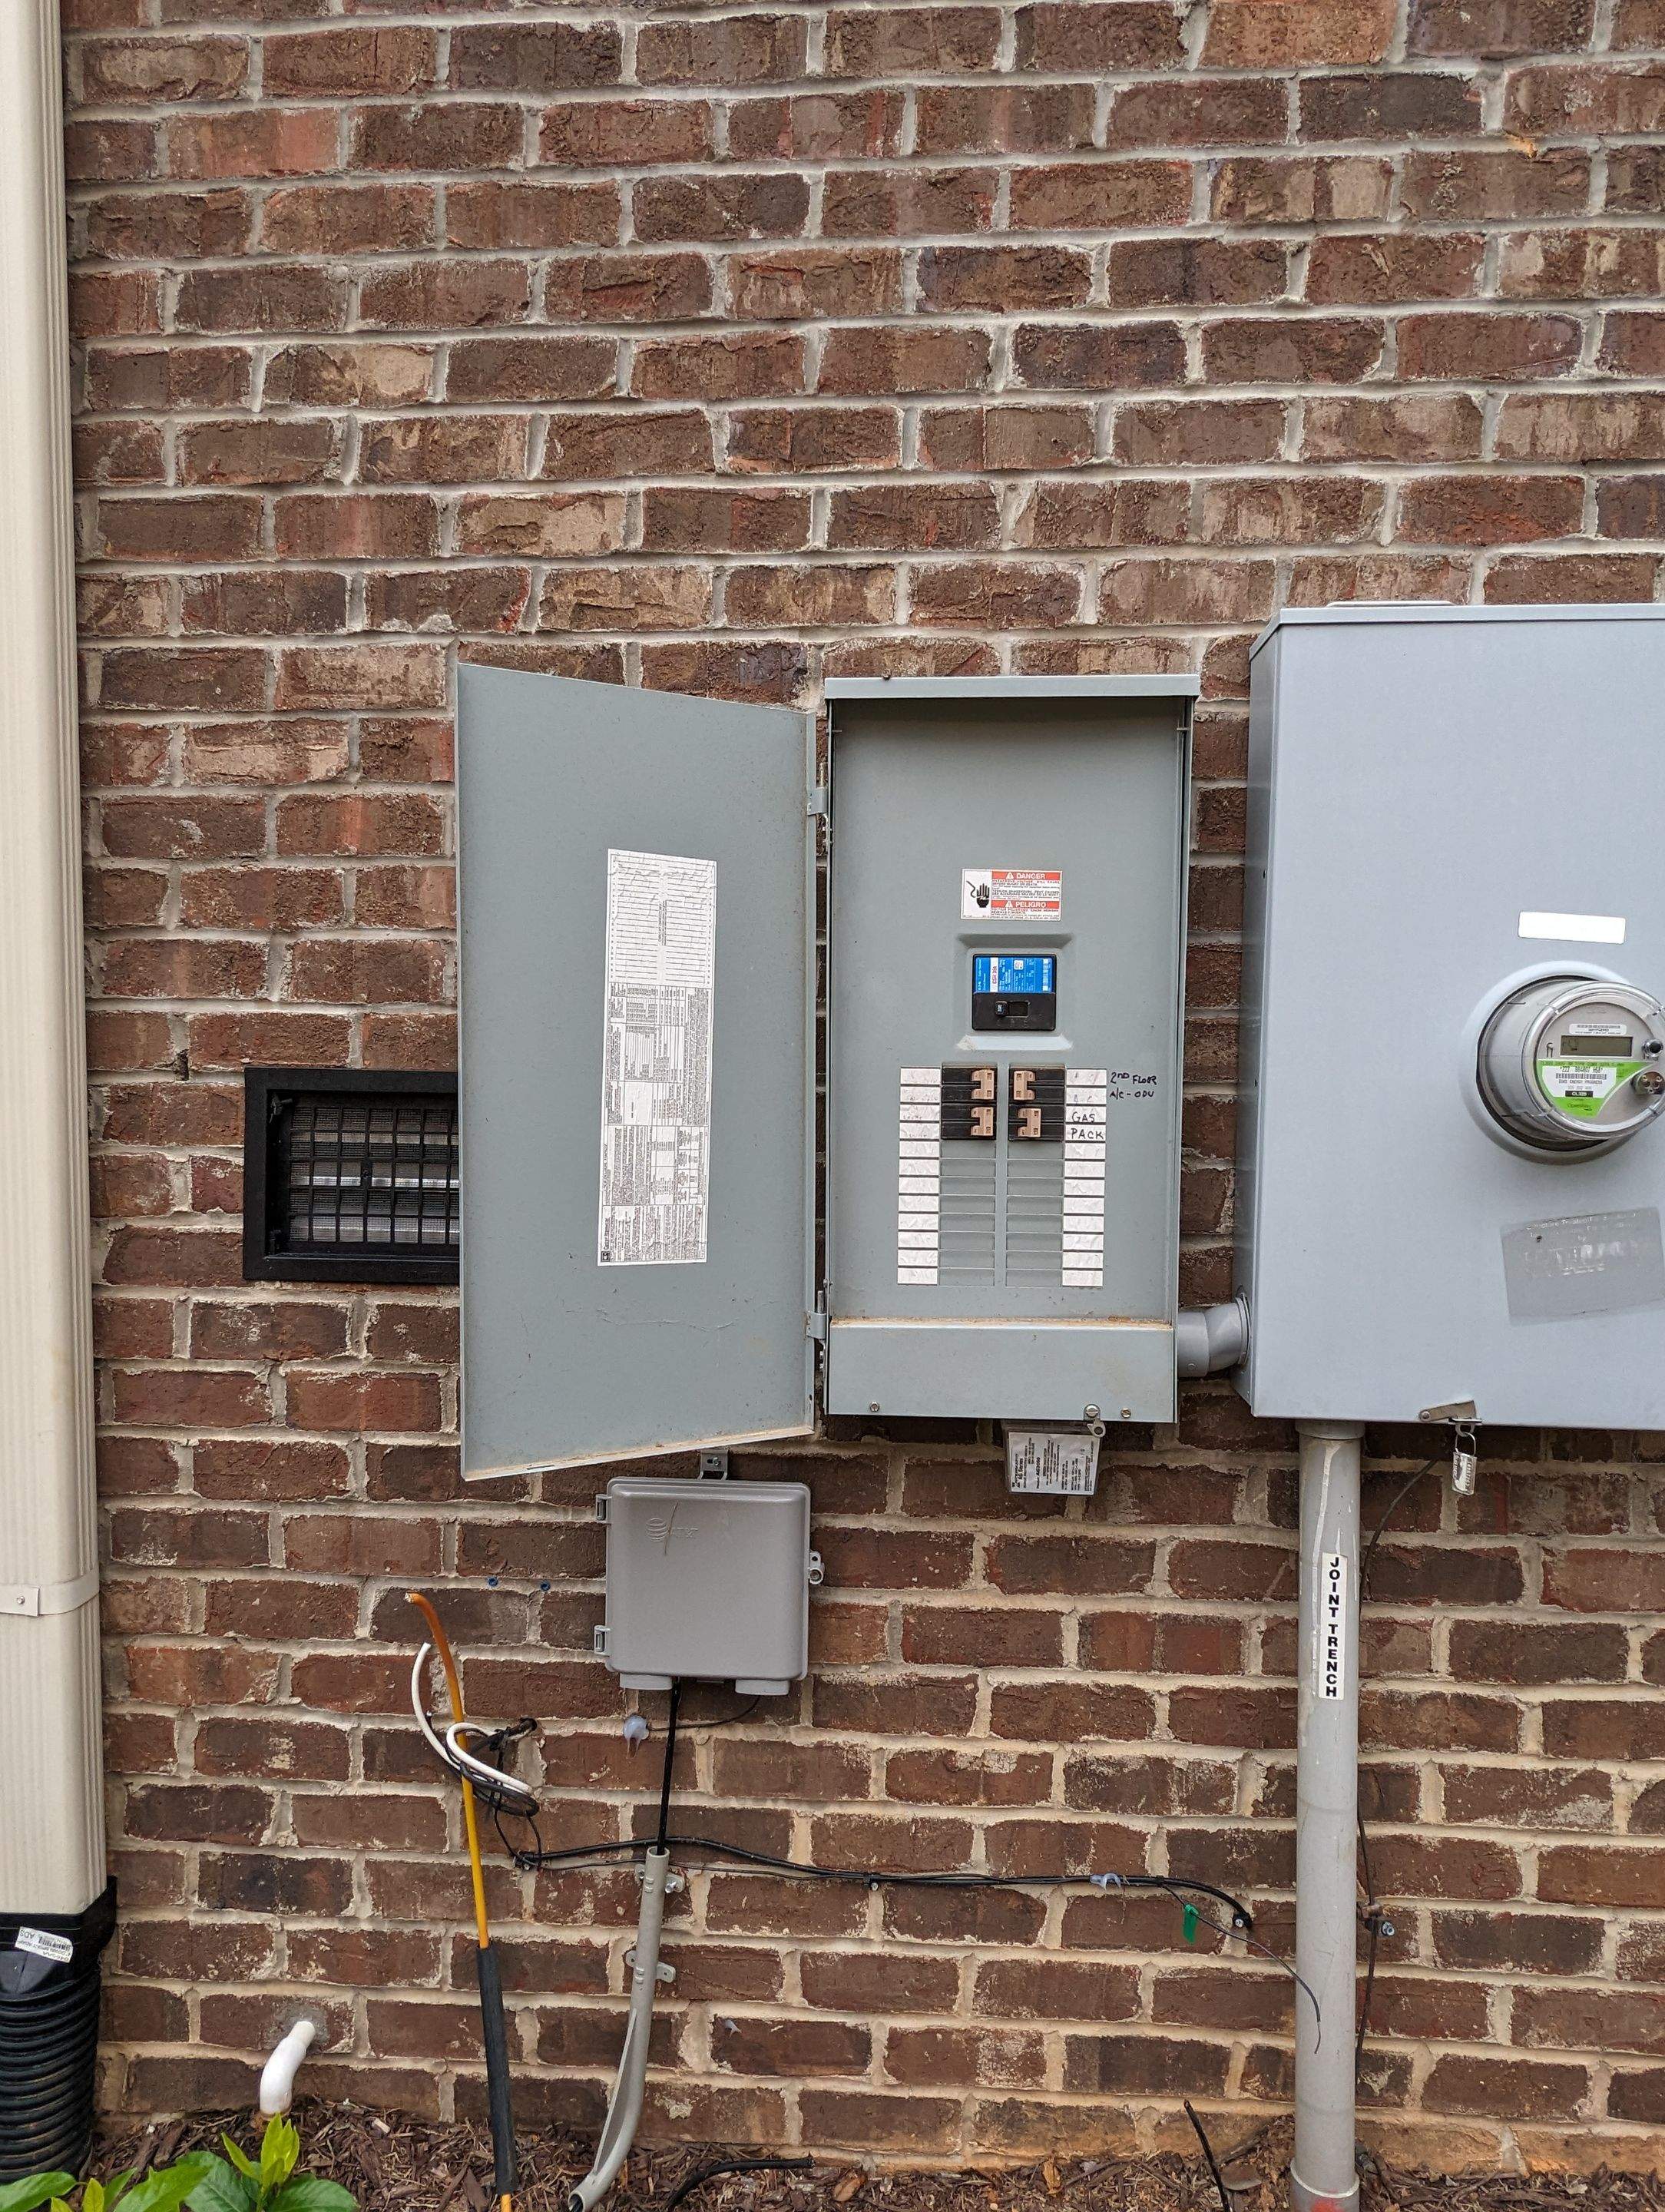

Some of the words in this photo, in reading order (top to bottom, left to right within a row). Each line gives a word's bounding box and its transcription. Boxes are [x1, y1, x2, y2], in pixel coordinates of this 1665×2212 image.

[1132, 1075, 1157, 1085] FLOOR
[1109, 1087, 1124, 1100] A/C
[1071, 1111, 1096, 1124] GAS
[1071, 1128, 1104, 1140] PACK
[1328, 1557, 1341, 1618] JOINT
[1326, 1624, 1339, 1697] TRENCH
[20, 1929, 35, 1939] ADS
